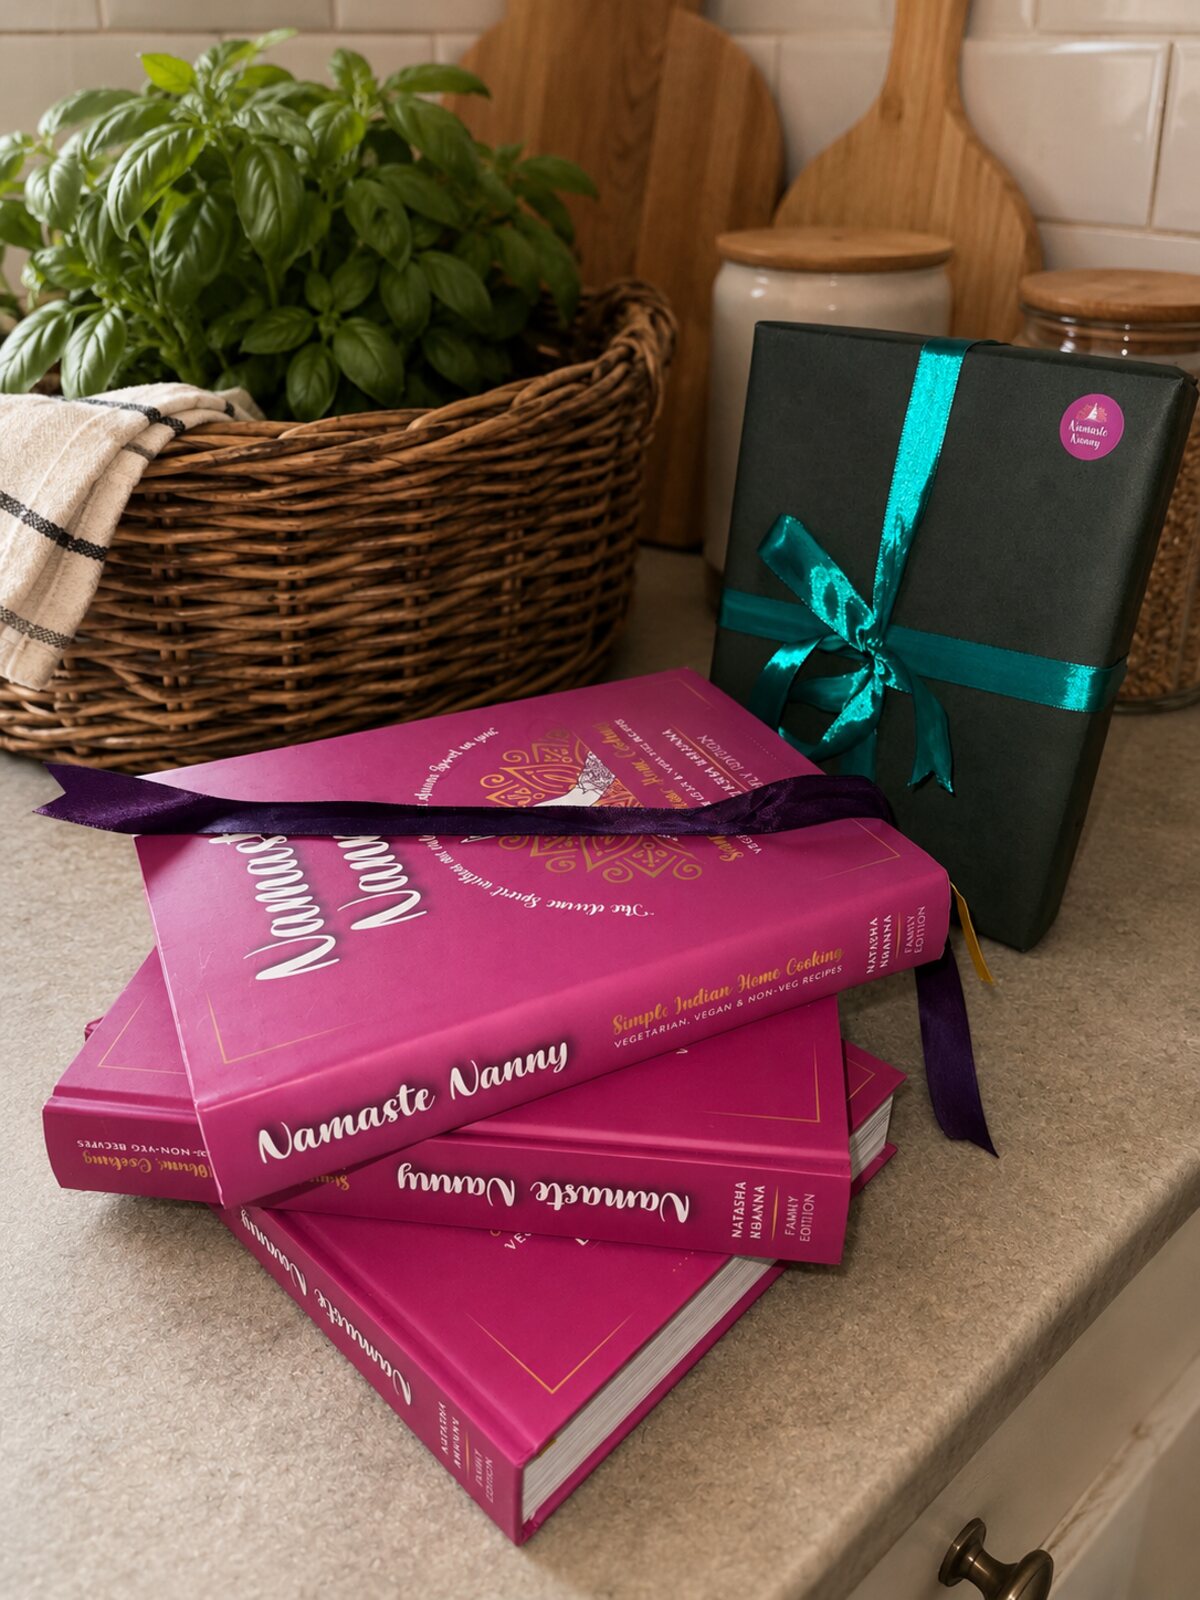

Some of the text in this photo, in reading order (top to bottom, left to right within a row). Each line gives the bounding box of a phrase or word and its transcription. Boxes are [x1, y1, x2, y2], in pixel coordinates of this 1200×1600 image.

[208, 833, 341, 981] Namast
[333, 834, 428, 931] Nan
[612, 948, 844, 1036] Simple Indian Home Cooking
[694, 1002, 733, 1021] VEGAN
[736, 999, 744, 1009] &
[748, 981, 799, 1004] NON-VEG
[802, 964, 844, 985] RECIPES
[258, 1042, 568, 1164] Namaste Nanny
[398, 1162, 515, 1207] Nanny
[530, 1181, 690, 1224] Namaste
[731, 1181, 746, 1239] NATASHA
